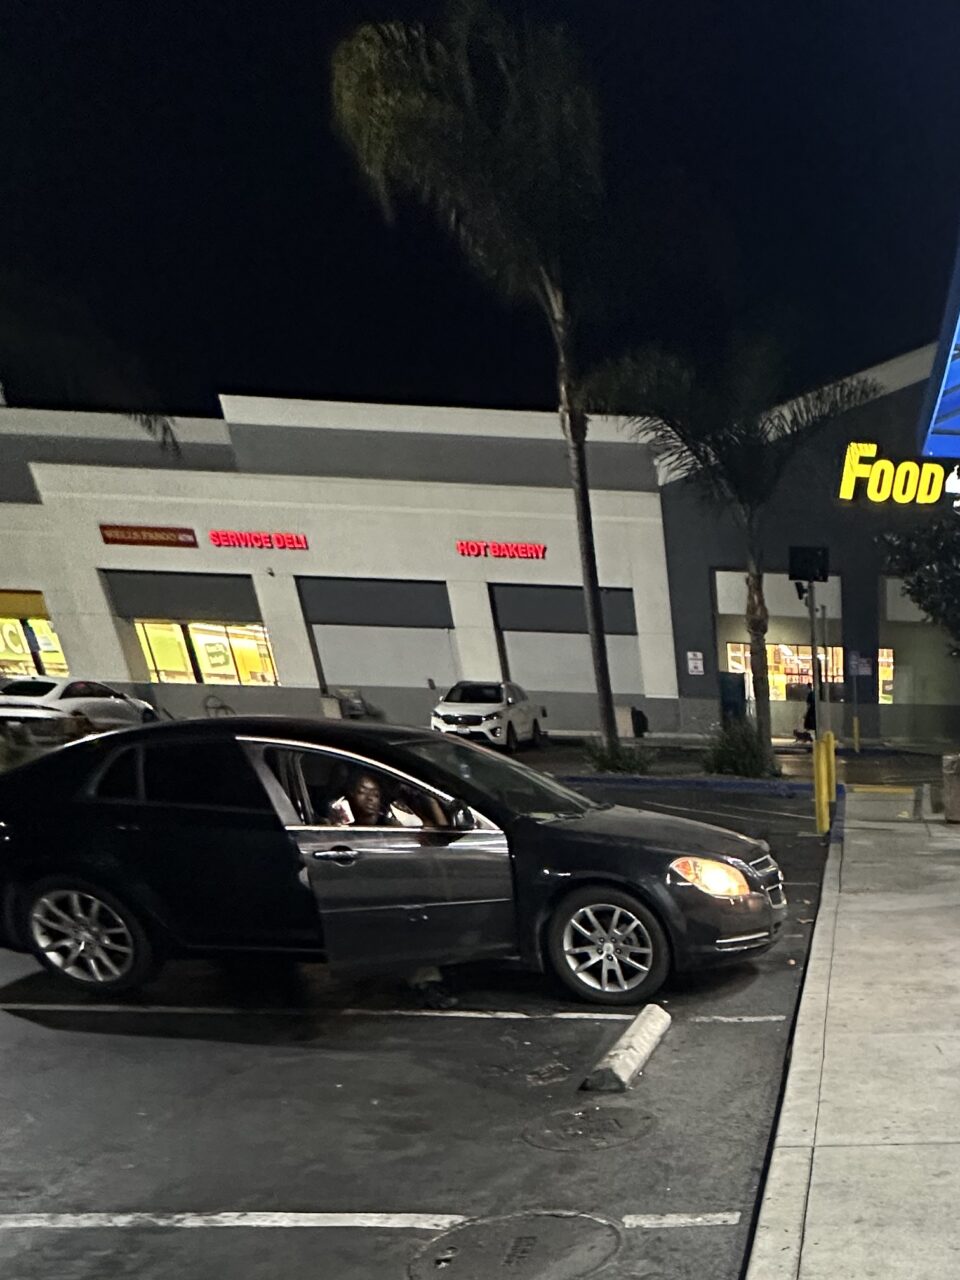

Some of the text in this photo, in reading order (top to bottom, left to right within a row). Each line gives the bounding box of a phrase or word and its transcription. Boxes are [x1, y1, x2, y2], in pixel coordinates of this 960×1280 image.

[839, 441, 945, 504] FOOD
[208, 529, 272, 548] SERVICE
[272, 533, 308, 549] DELI
[456, 540, 547, 559] HOT BAKERY
